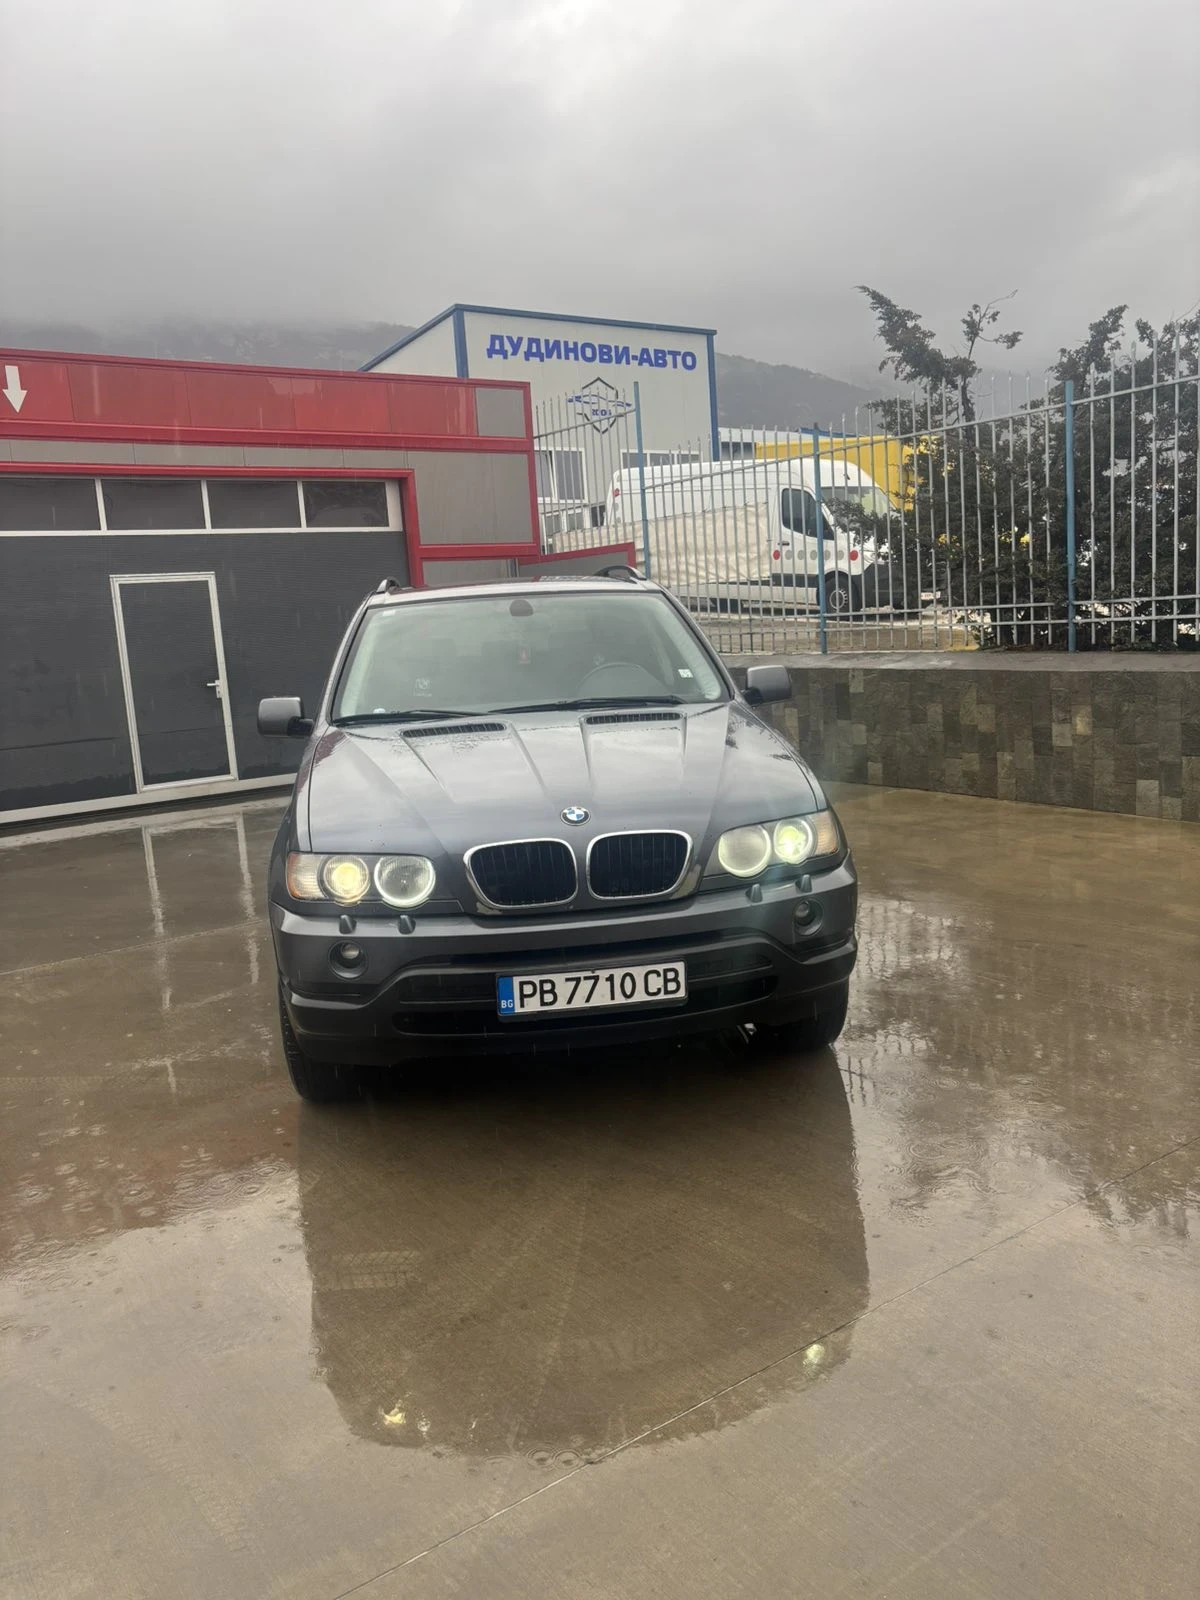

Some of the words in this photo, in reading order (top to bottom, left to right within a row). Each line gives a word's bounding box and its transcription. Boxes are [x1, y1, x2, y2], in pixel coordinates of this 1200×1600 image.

[486, 334, 697, 370] ДУДИНОВИ-АВТО
[501, 999, 514, 1009] BG
[518, 979, 558, 1008] PB
[564, 972, 636, 1005] 7710
[643, 967, 681, 997] CB
